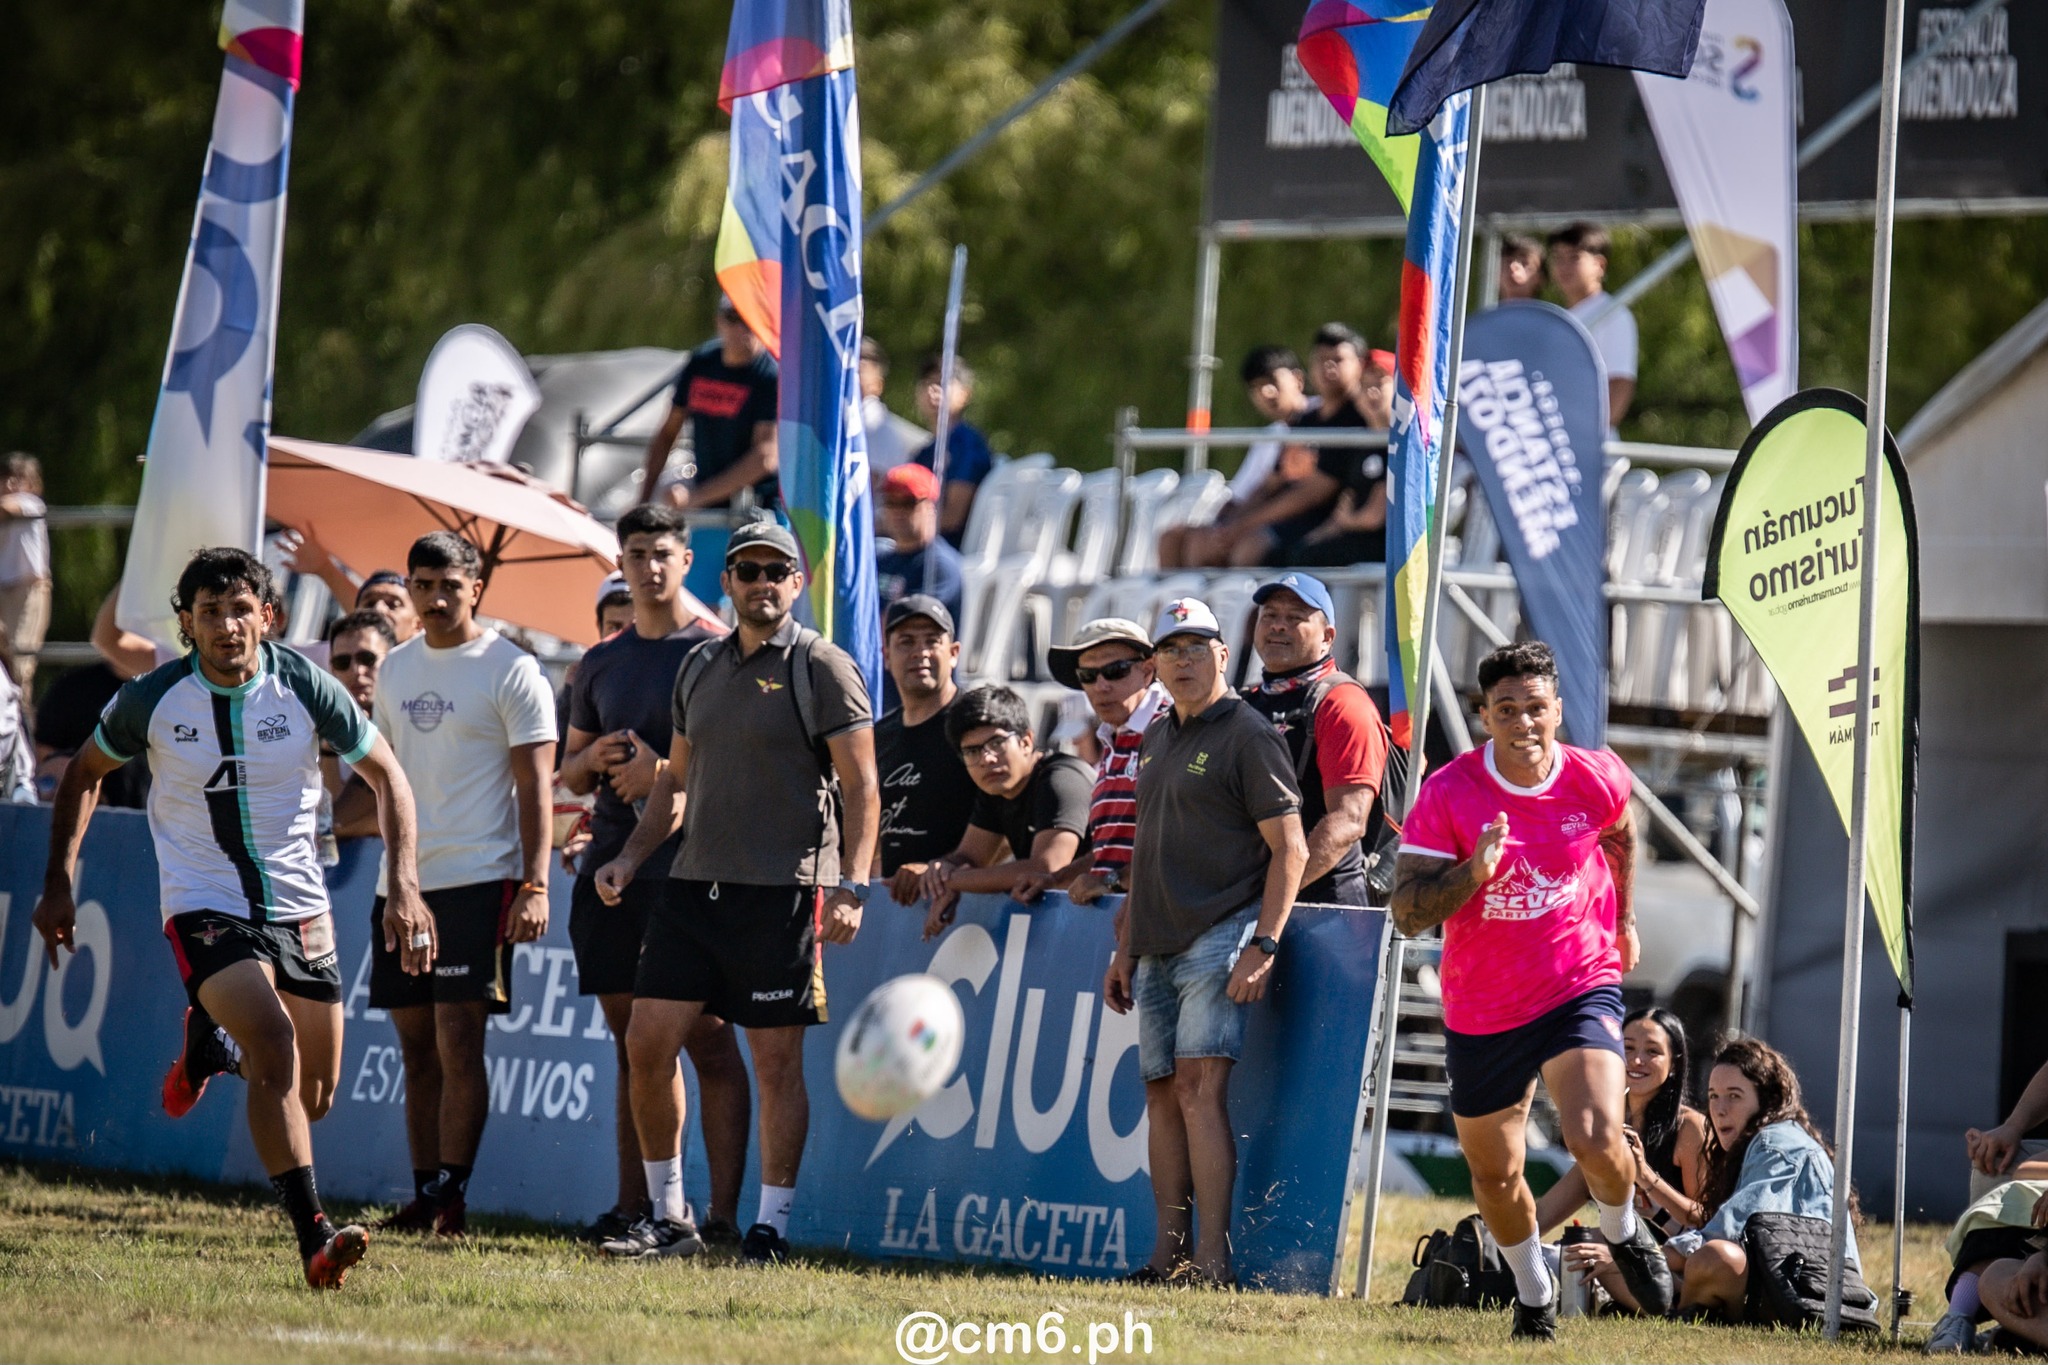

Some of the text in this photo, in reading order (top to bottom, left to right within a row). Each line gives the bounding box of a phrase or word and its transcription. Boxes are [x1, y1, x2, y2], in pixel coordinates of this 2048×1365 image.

[401, 699, 455, 713] MEDUSA
[883, 763, 921, 787] Art
[891, 796, 907, 818] of
[1488, 911, 1532, 919] PARTY
[352, 1045, 406, 1104] EST
[521, 1056, 595, 1121] VOS
[879, 1187, 1129, 1270] LA GACETA
